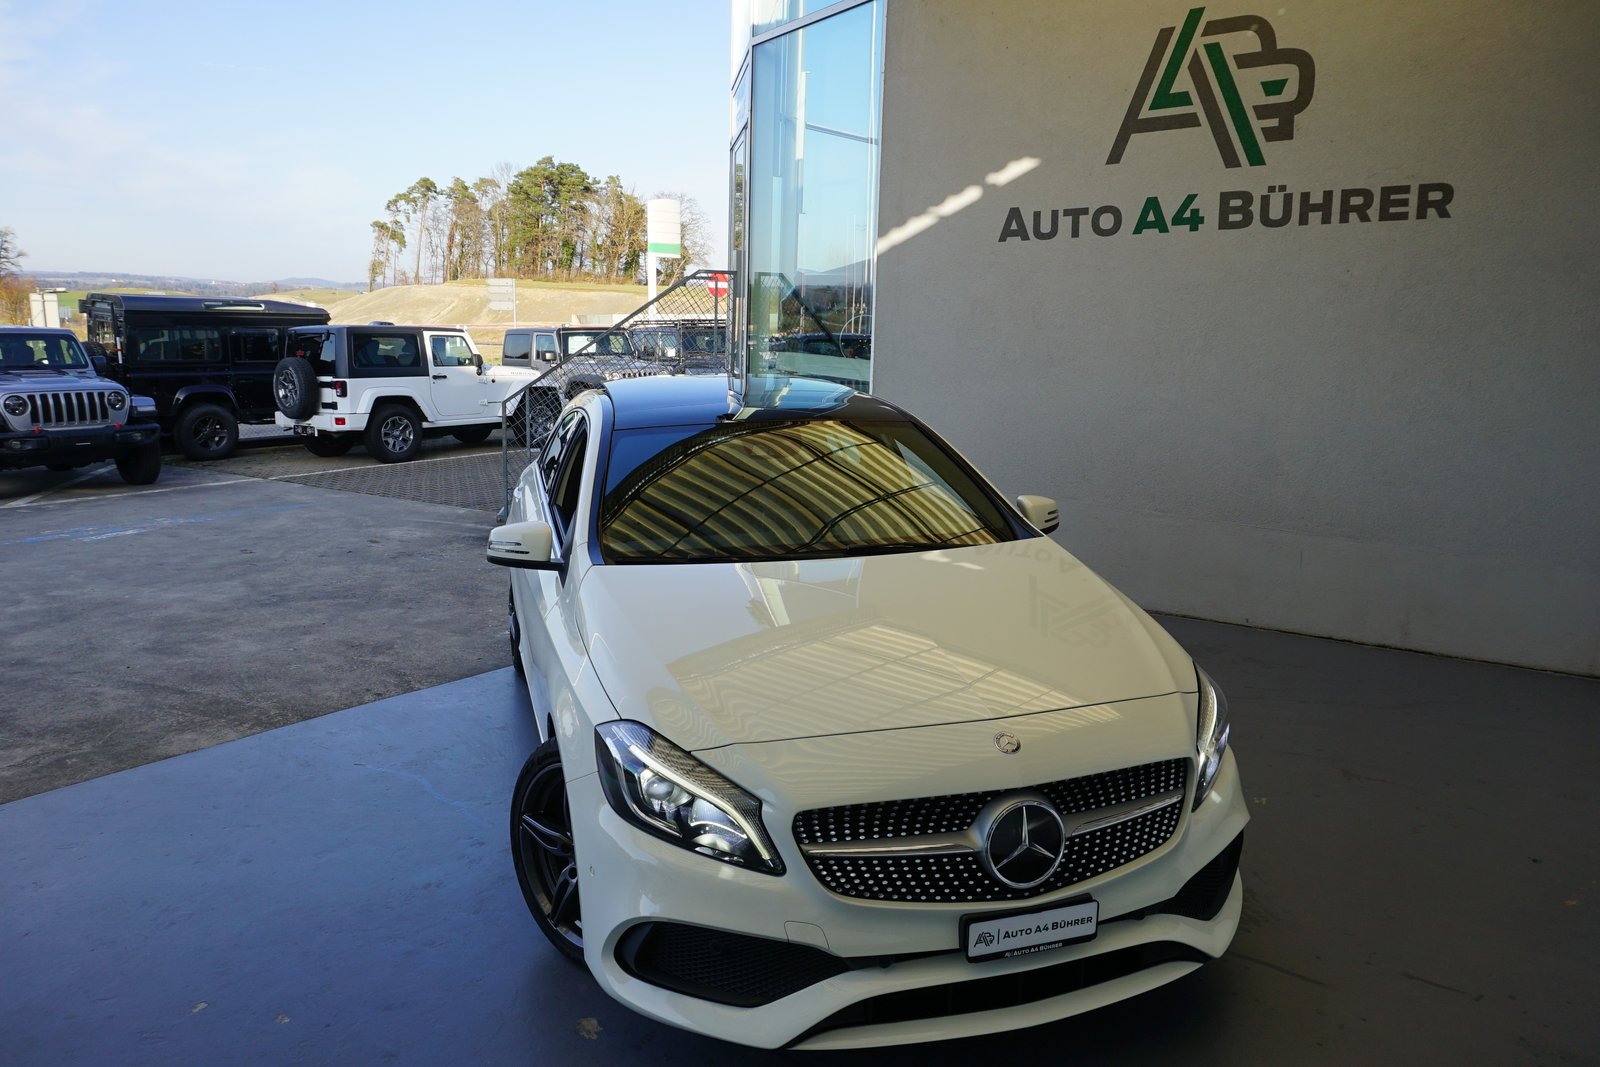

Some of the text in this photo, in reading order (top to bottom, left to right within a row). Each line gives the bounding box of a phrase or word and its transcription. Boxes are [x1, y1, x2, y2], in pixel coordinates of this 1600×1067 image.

[998, 182, 1455, 242] AUTO A4 BÜHRER
[1002, 916, 1093, 940] AUTO A4 BÜHRER
